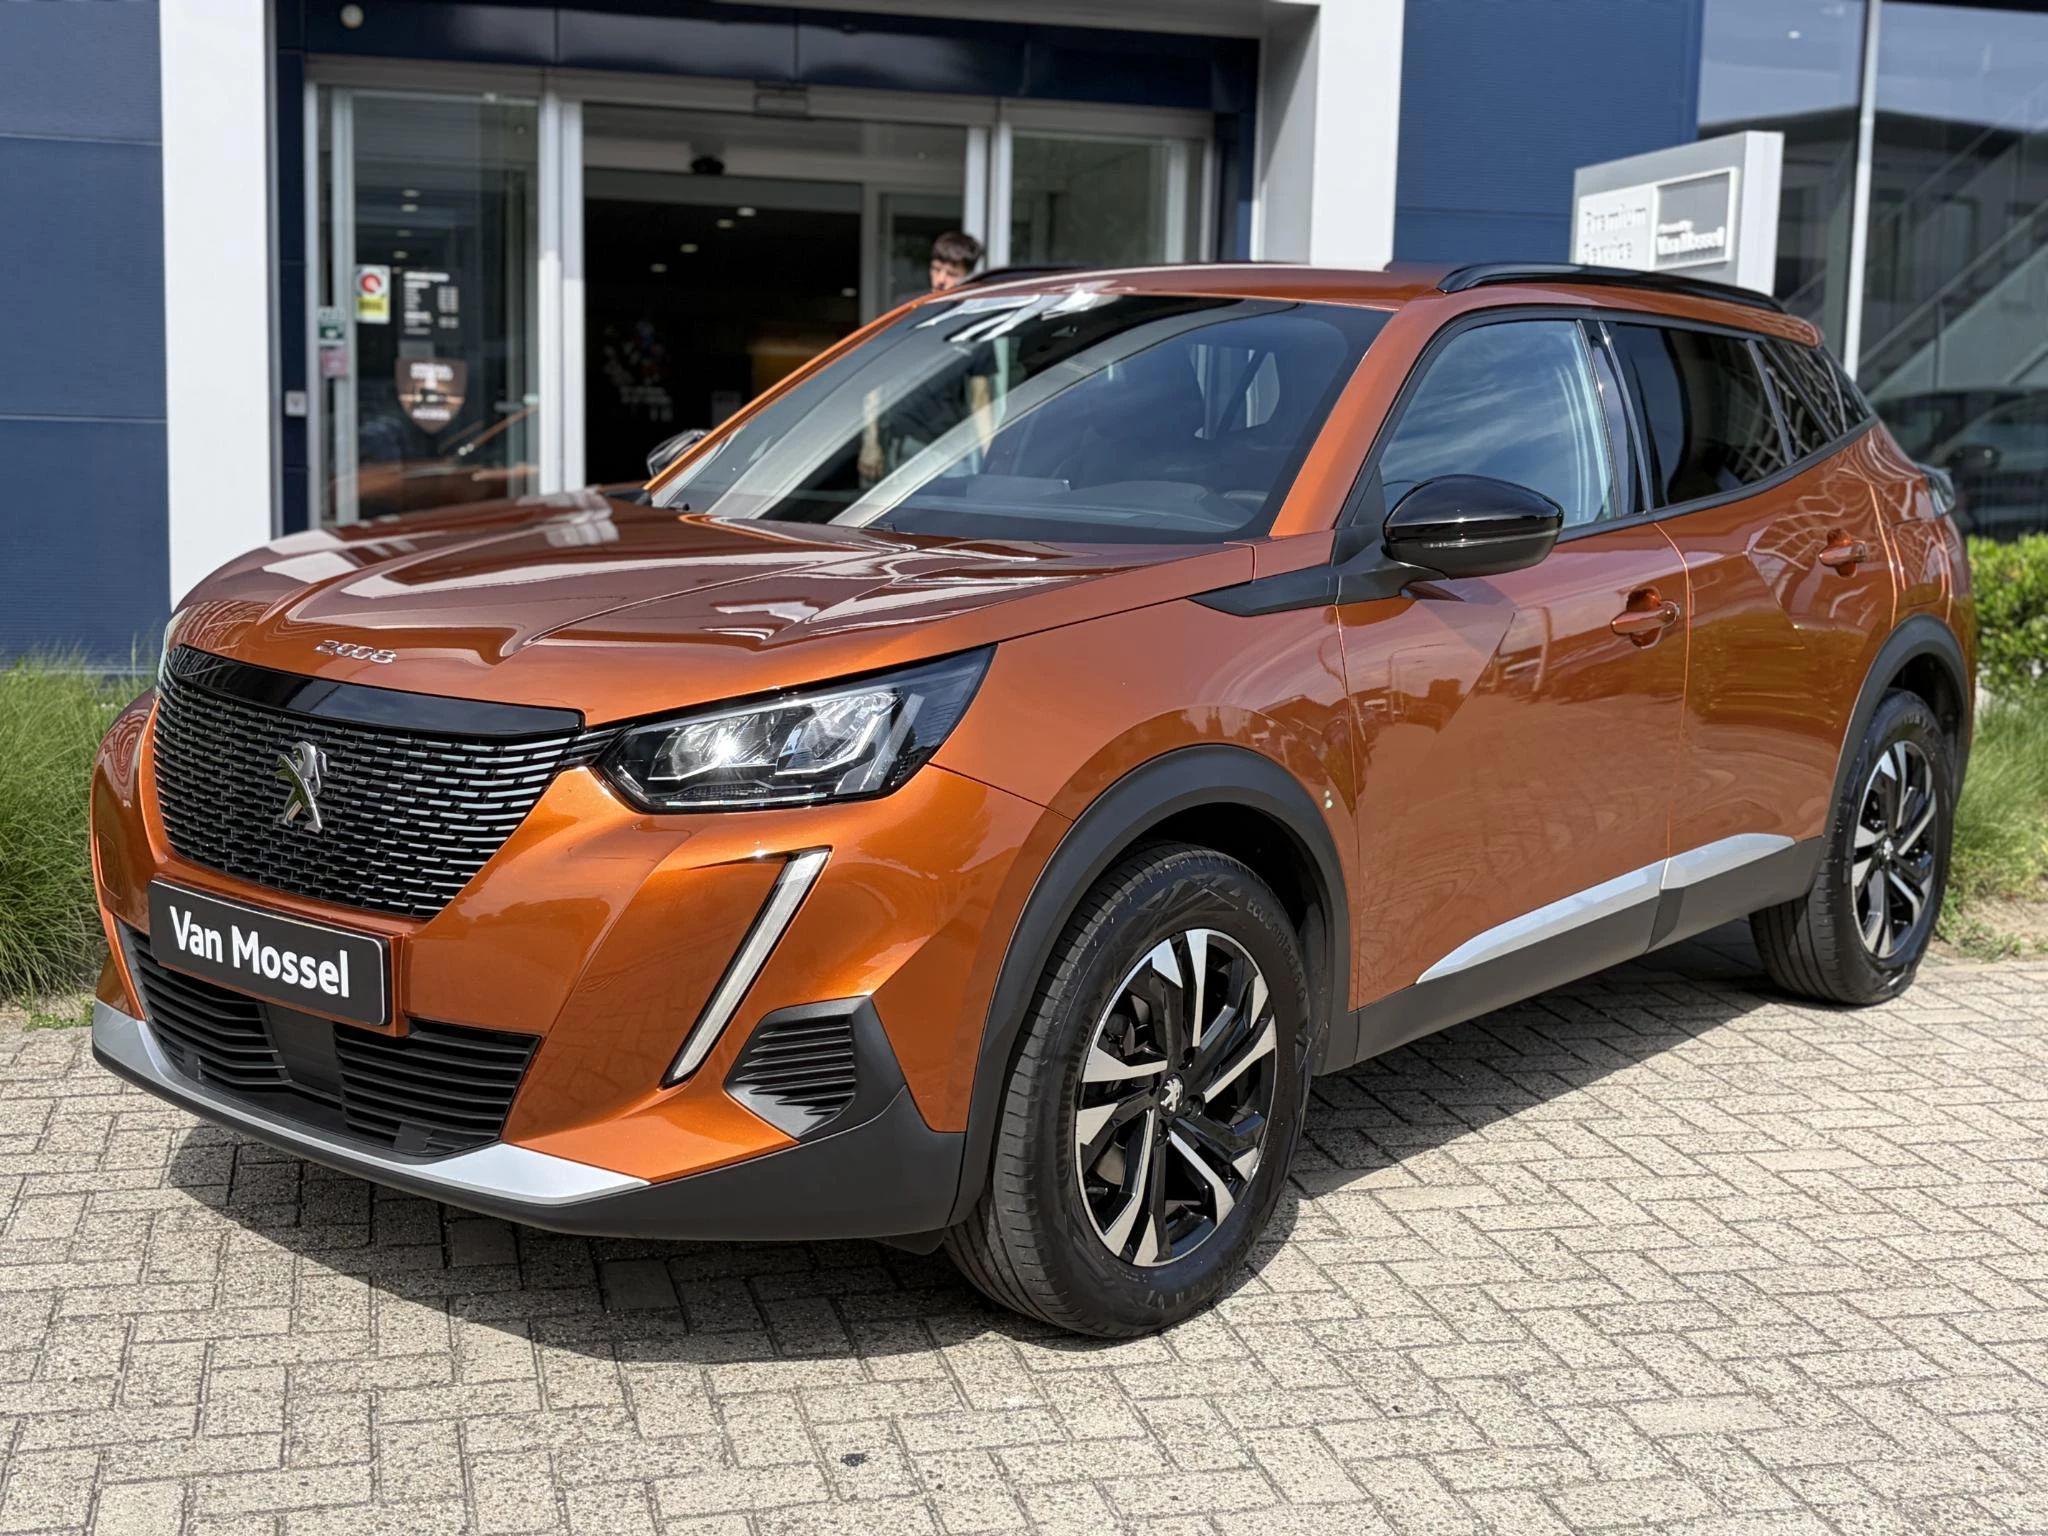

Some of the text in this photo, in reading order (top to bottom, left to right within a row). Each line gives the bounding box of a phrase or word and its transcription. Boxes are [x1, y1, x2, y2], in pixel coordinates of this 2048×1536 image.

[314, 639, 397, 664] 2008
[169, 905, 350, 999] Van Mossel
